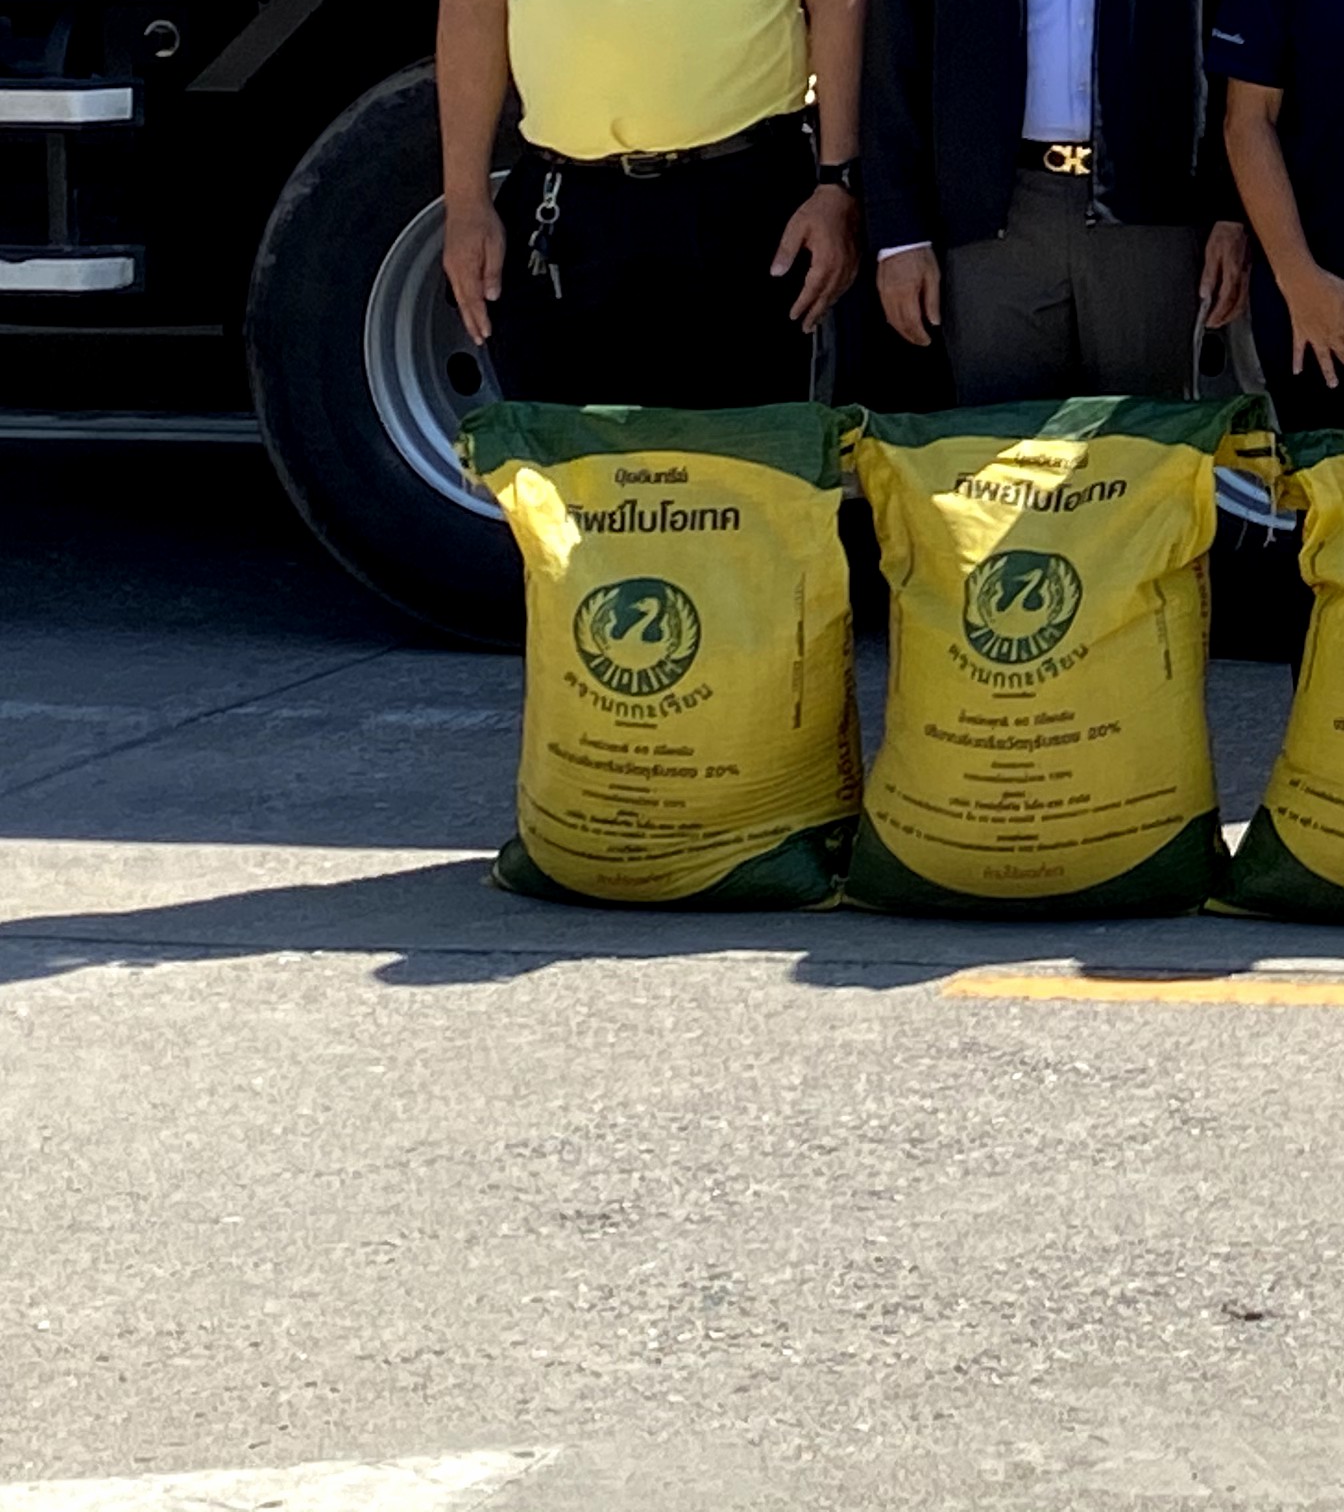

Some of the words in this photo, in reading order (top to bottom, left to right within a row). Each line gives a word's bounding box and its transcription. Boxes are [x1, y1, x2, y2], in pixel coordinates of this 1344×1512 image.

[563, 669, 716, 719] ตรานกกะเรียน
